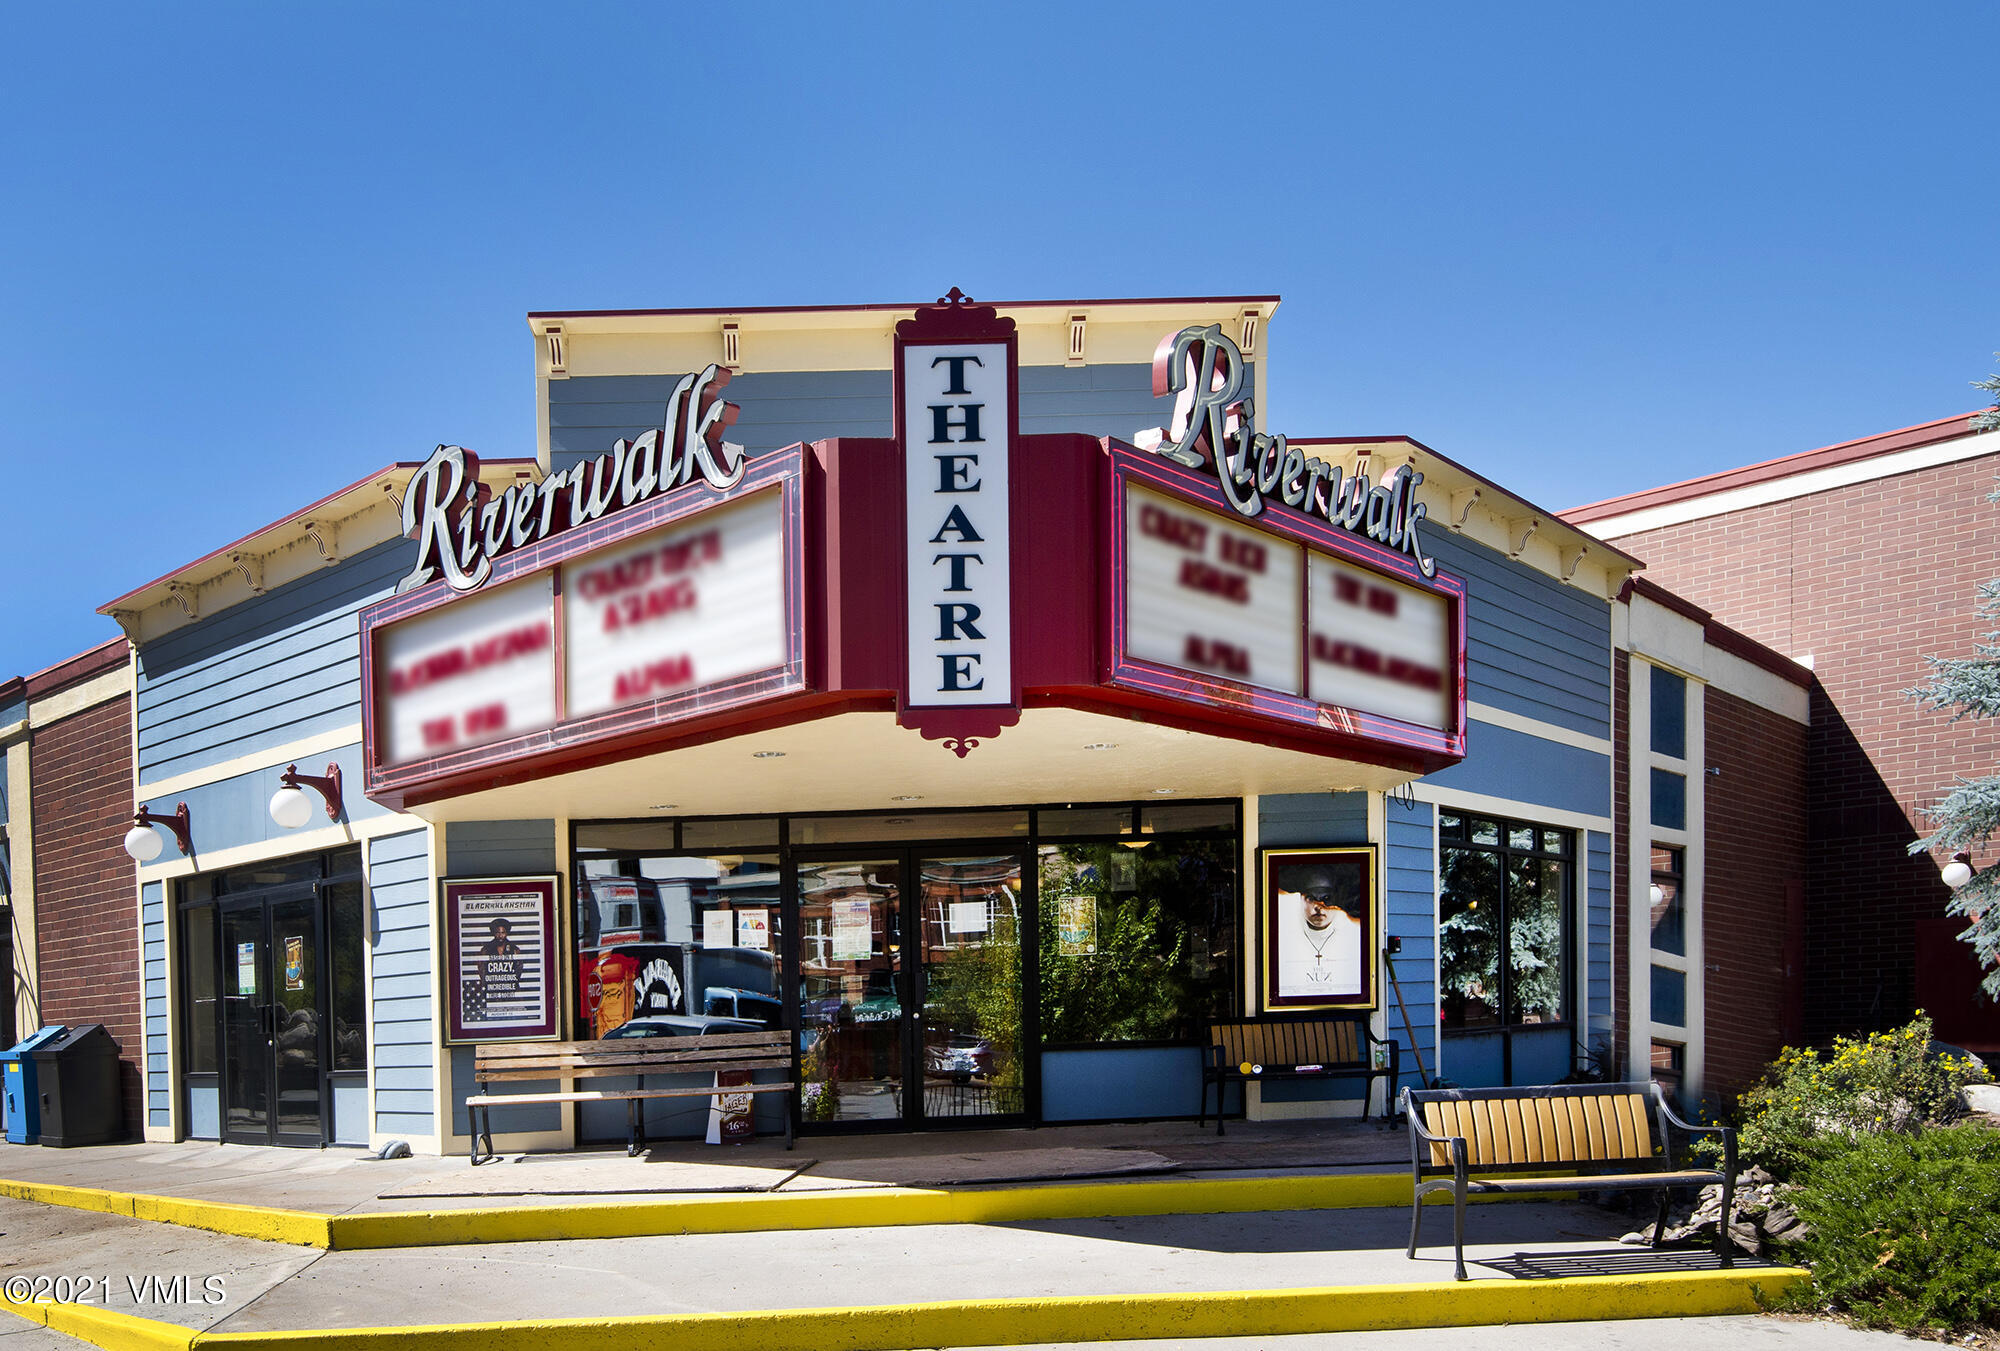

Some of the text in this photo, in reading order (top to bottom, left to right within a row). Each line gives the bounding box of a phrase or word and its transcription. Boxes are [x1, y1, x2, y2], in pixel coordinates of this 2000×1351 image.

[394, 363, 747, 594] Riverwalk
[927, 355, 987, 692] THEATRE
[1153, 323, 1437, 579] Riverwalk
[488, 962, 515, 973] CRAZY,
